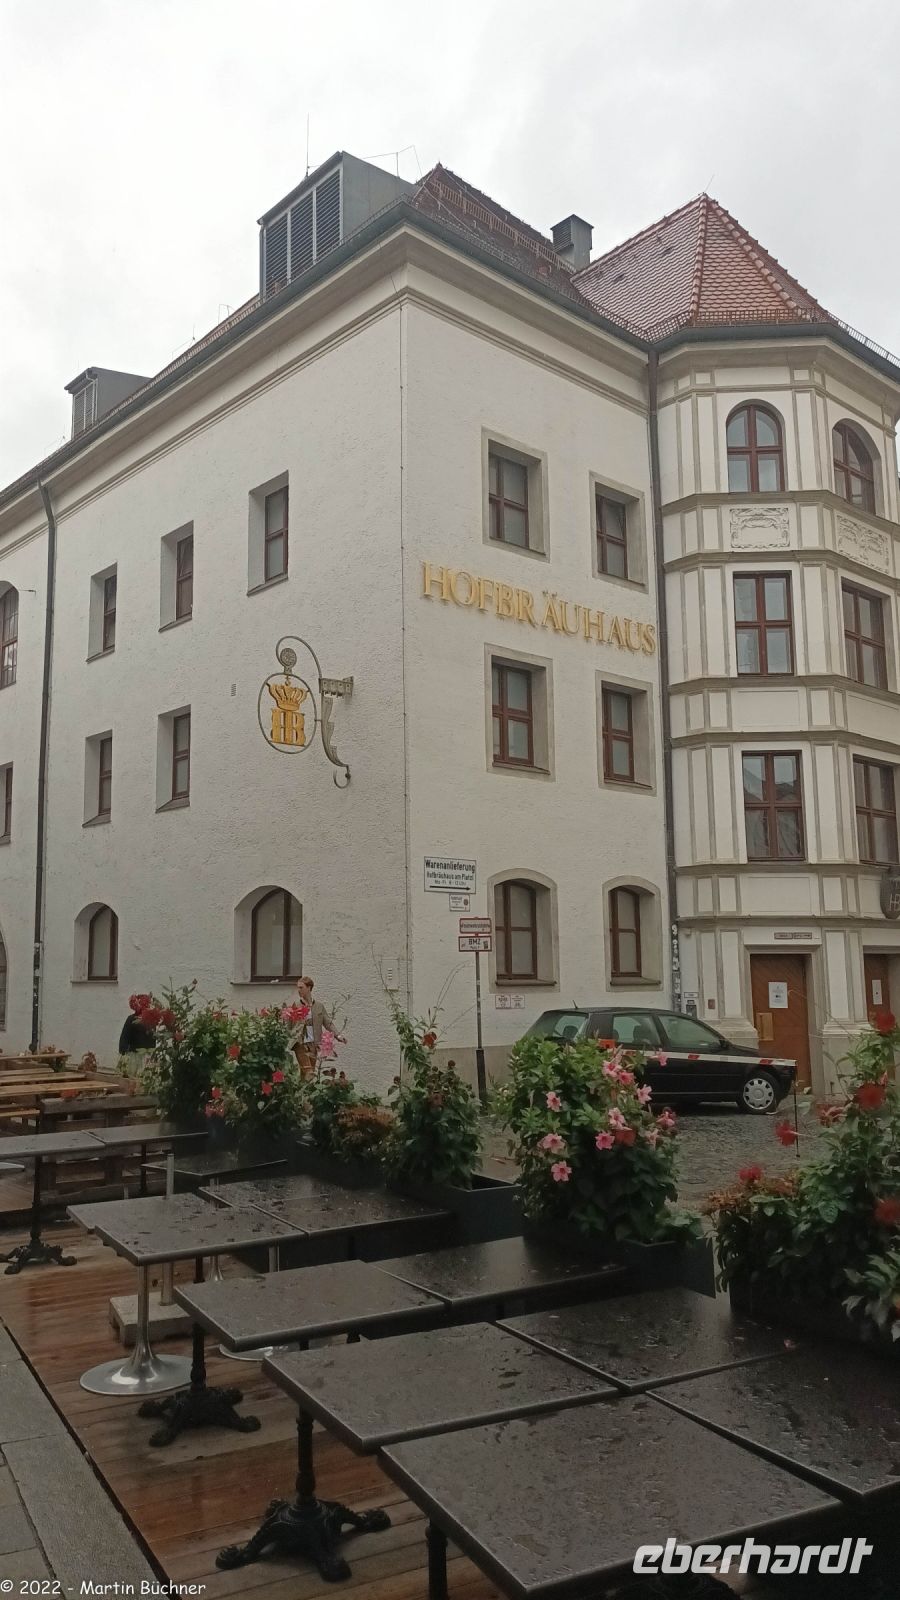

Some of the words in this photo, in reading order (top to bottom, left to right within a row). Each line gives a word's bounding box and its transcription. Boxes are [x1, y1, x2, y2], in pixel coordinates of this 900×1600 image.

[422, 560, 656, 655] HOFBRÄUHAUS
[271, 708, 306, 747] HB
[425, 859, 476, 874] Warenanlieferung
